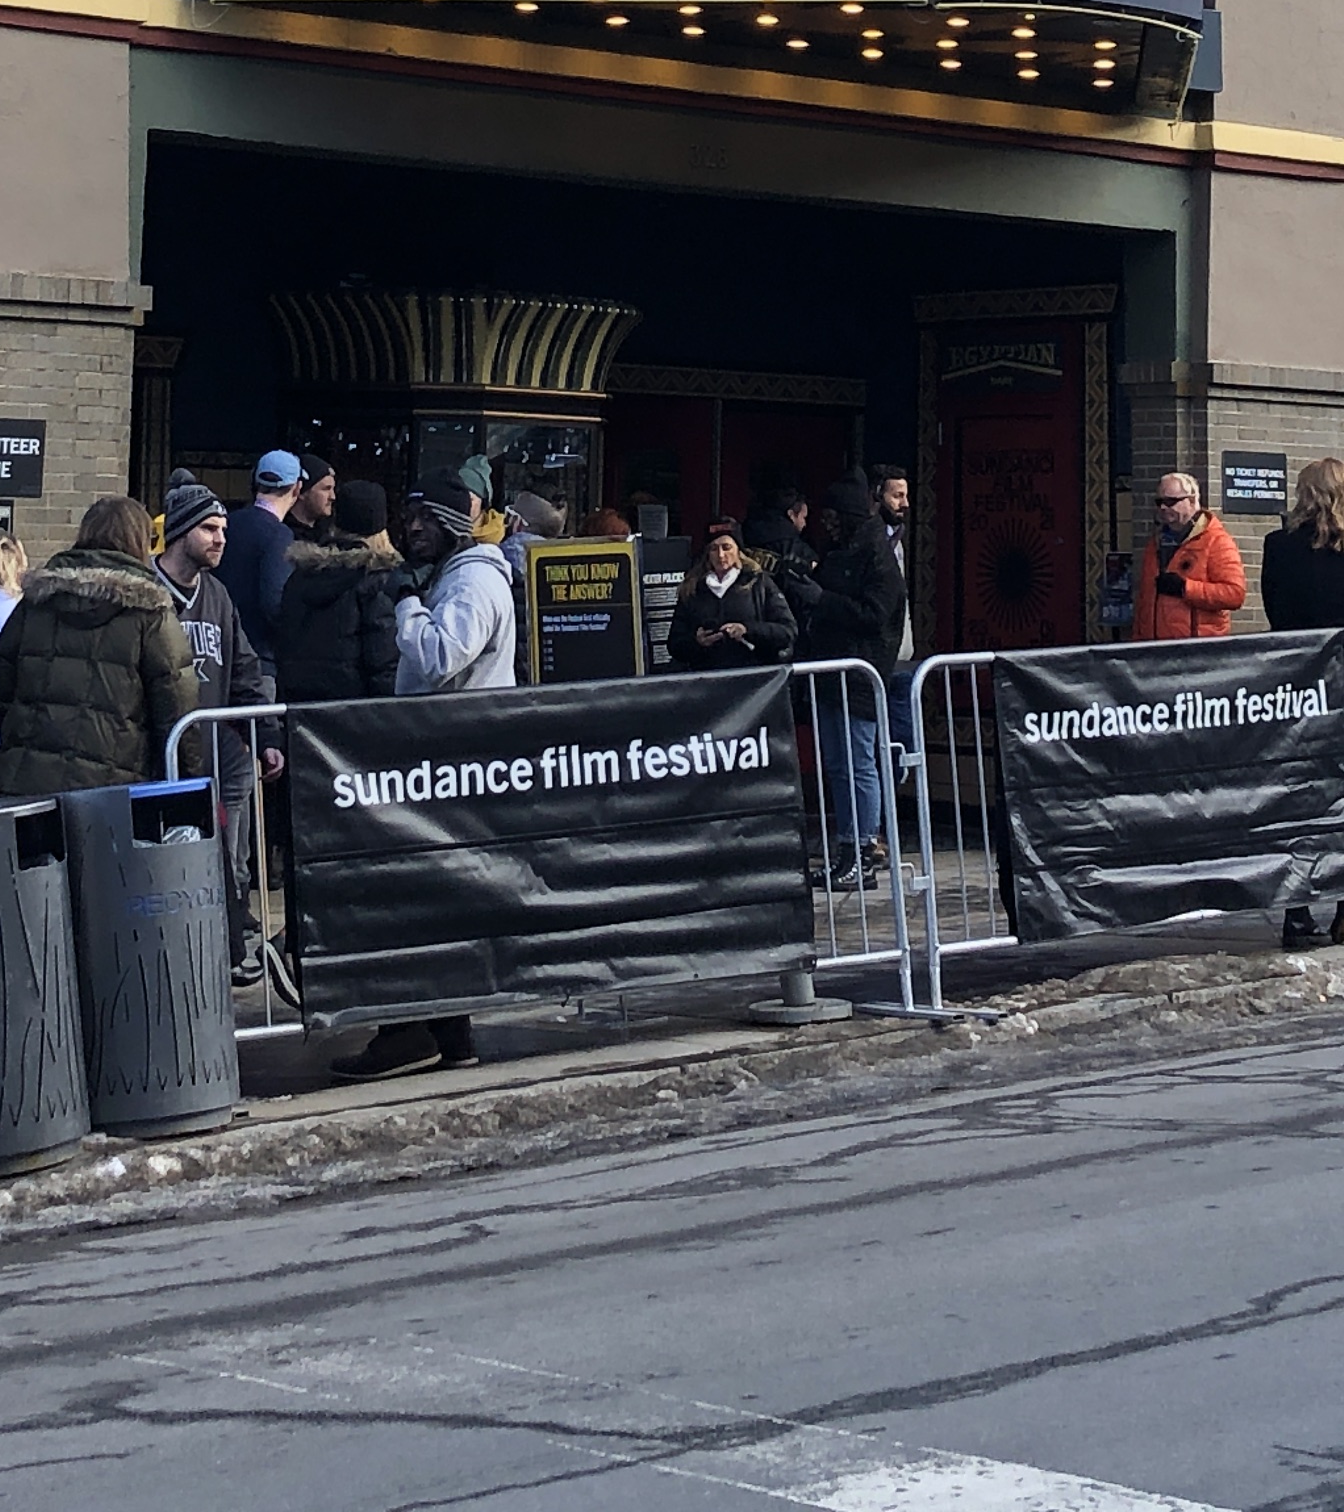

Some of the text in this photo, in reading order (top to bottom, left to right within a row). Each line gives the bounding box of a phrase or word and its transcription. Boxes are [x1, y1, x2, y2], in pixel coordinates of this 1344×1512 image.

[948, 342, 1057, 369] EGYPTIAN
[570, 563, 589, 581] YOU
[551, 582, 614, 602] THE ANSWER?
[1024, 679, 1329, 745] sundance film festival
[333, 726, 772, 809] sundance film festival
